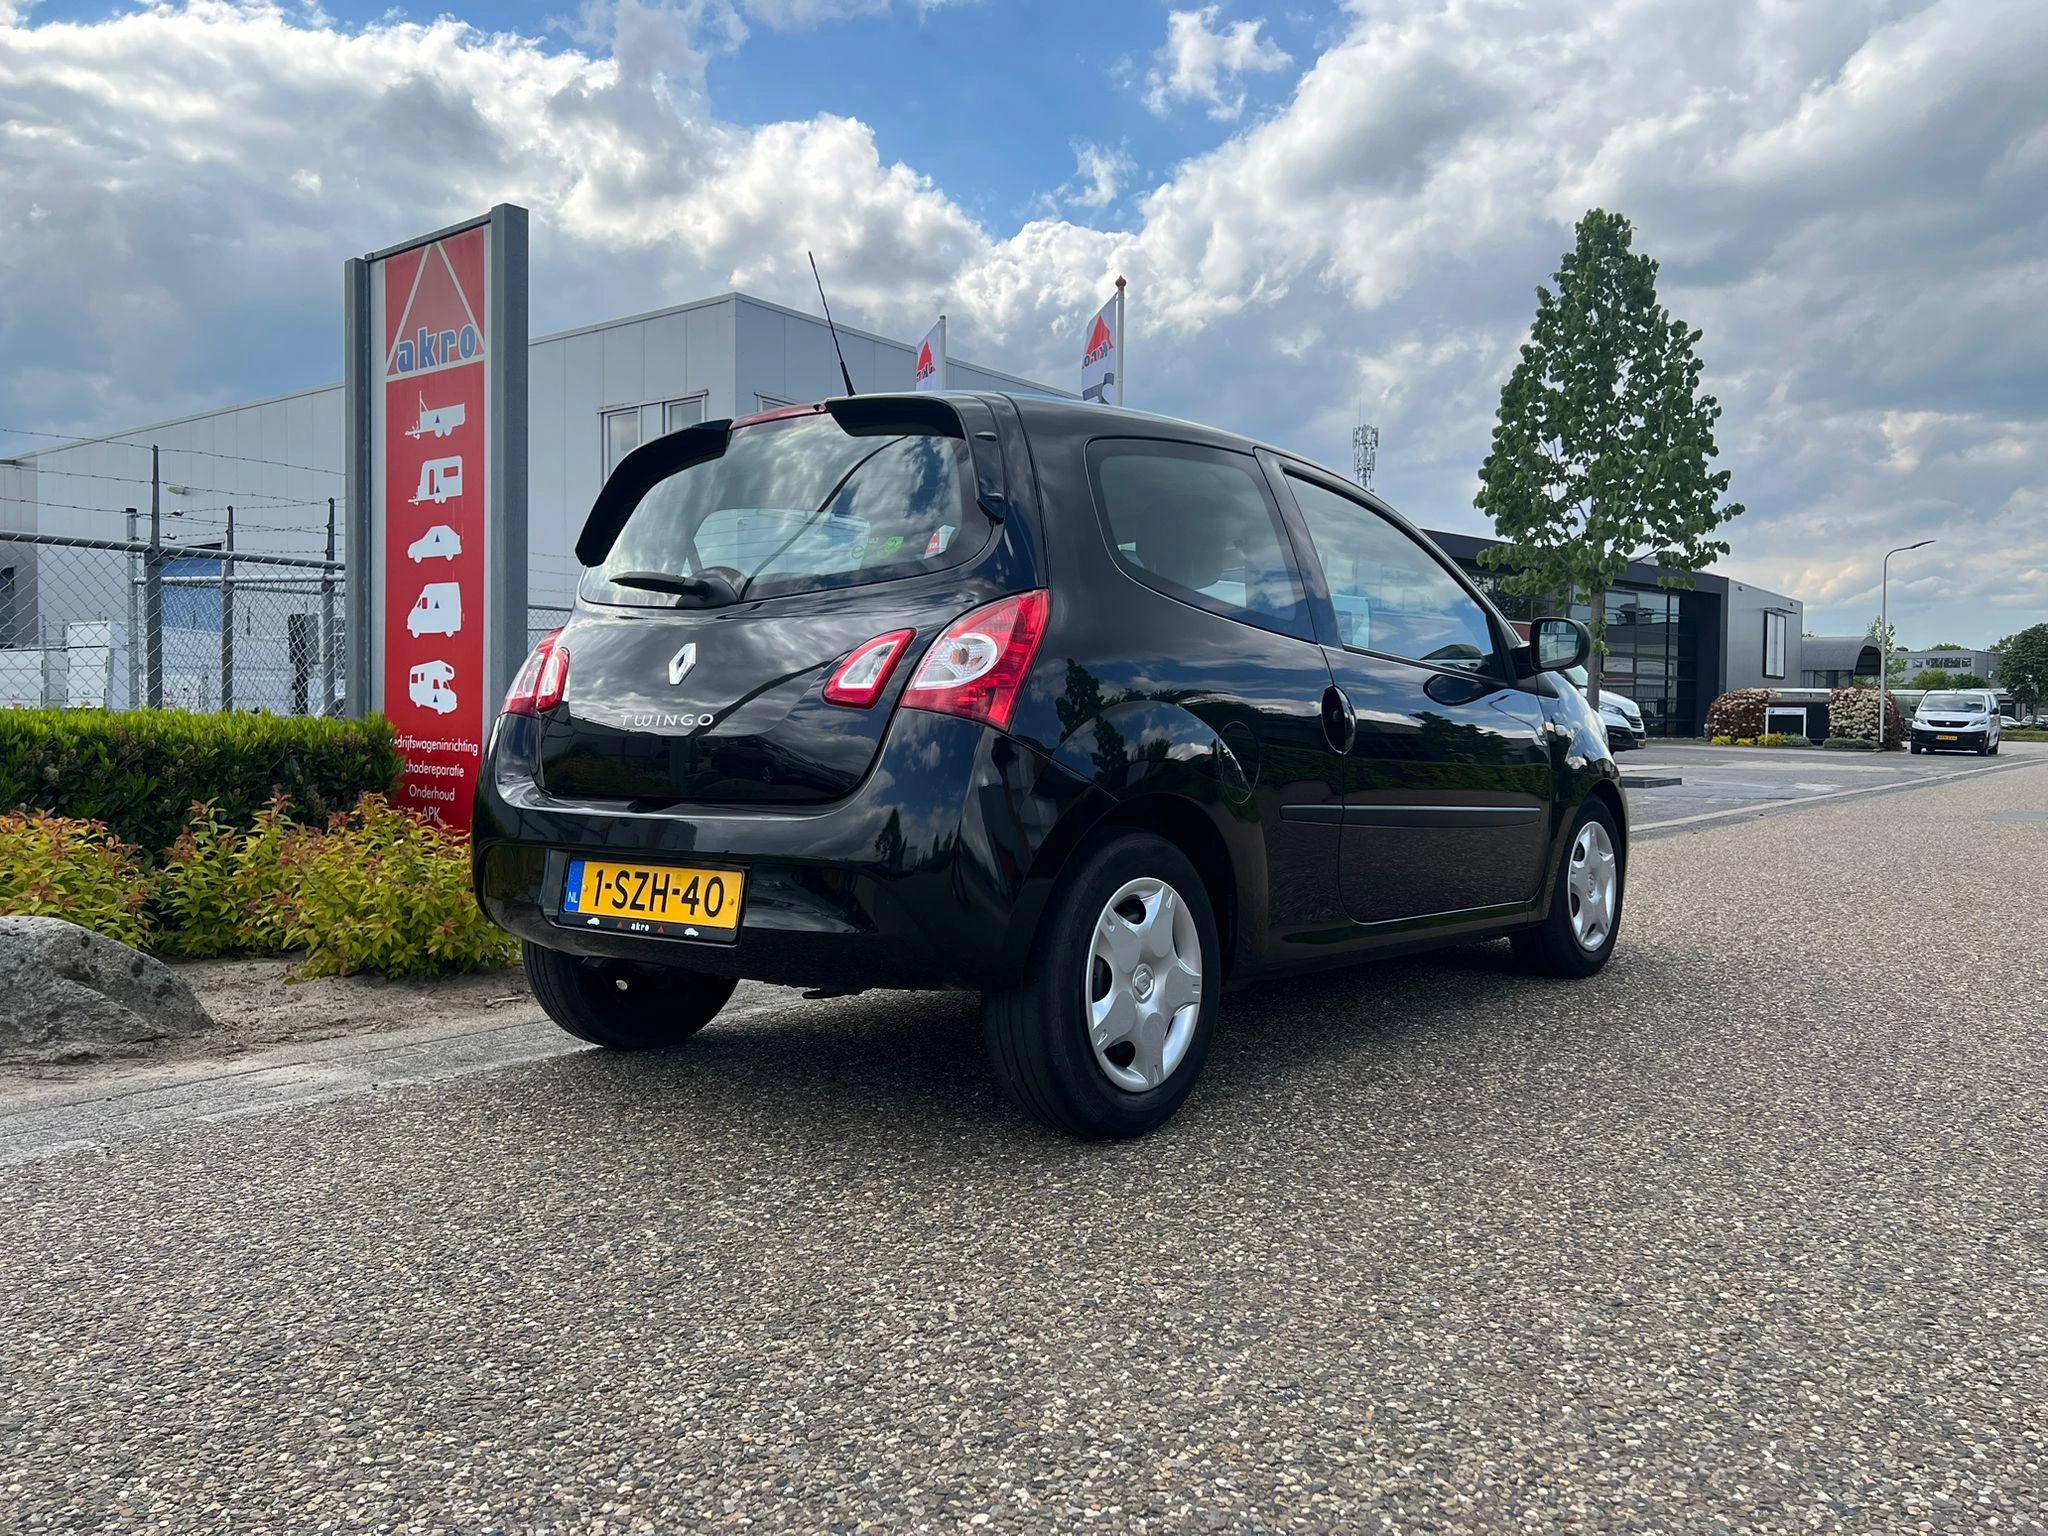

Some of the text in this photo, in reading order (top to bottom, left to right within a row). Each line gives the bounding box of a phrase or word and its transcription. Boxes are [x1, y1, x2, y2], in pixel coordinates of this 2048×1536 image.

[396, 323, 478, 374] akro
[620, 713, 714, 727] TWINGO
[393, 734, 479, 757] drijfswageninrichting
[405, 759, 465, 778] chadereparatie
[408, 783, 456, 801] Onderhoud
[421, 805, 441, 822] APK
[567, 891, 579, 904] NL
[594, 869, 726, 919] 1-SZH-40
[630, 921, 650, 932] akro
